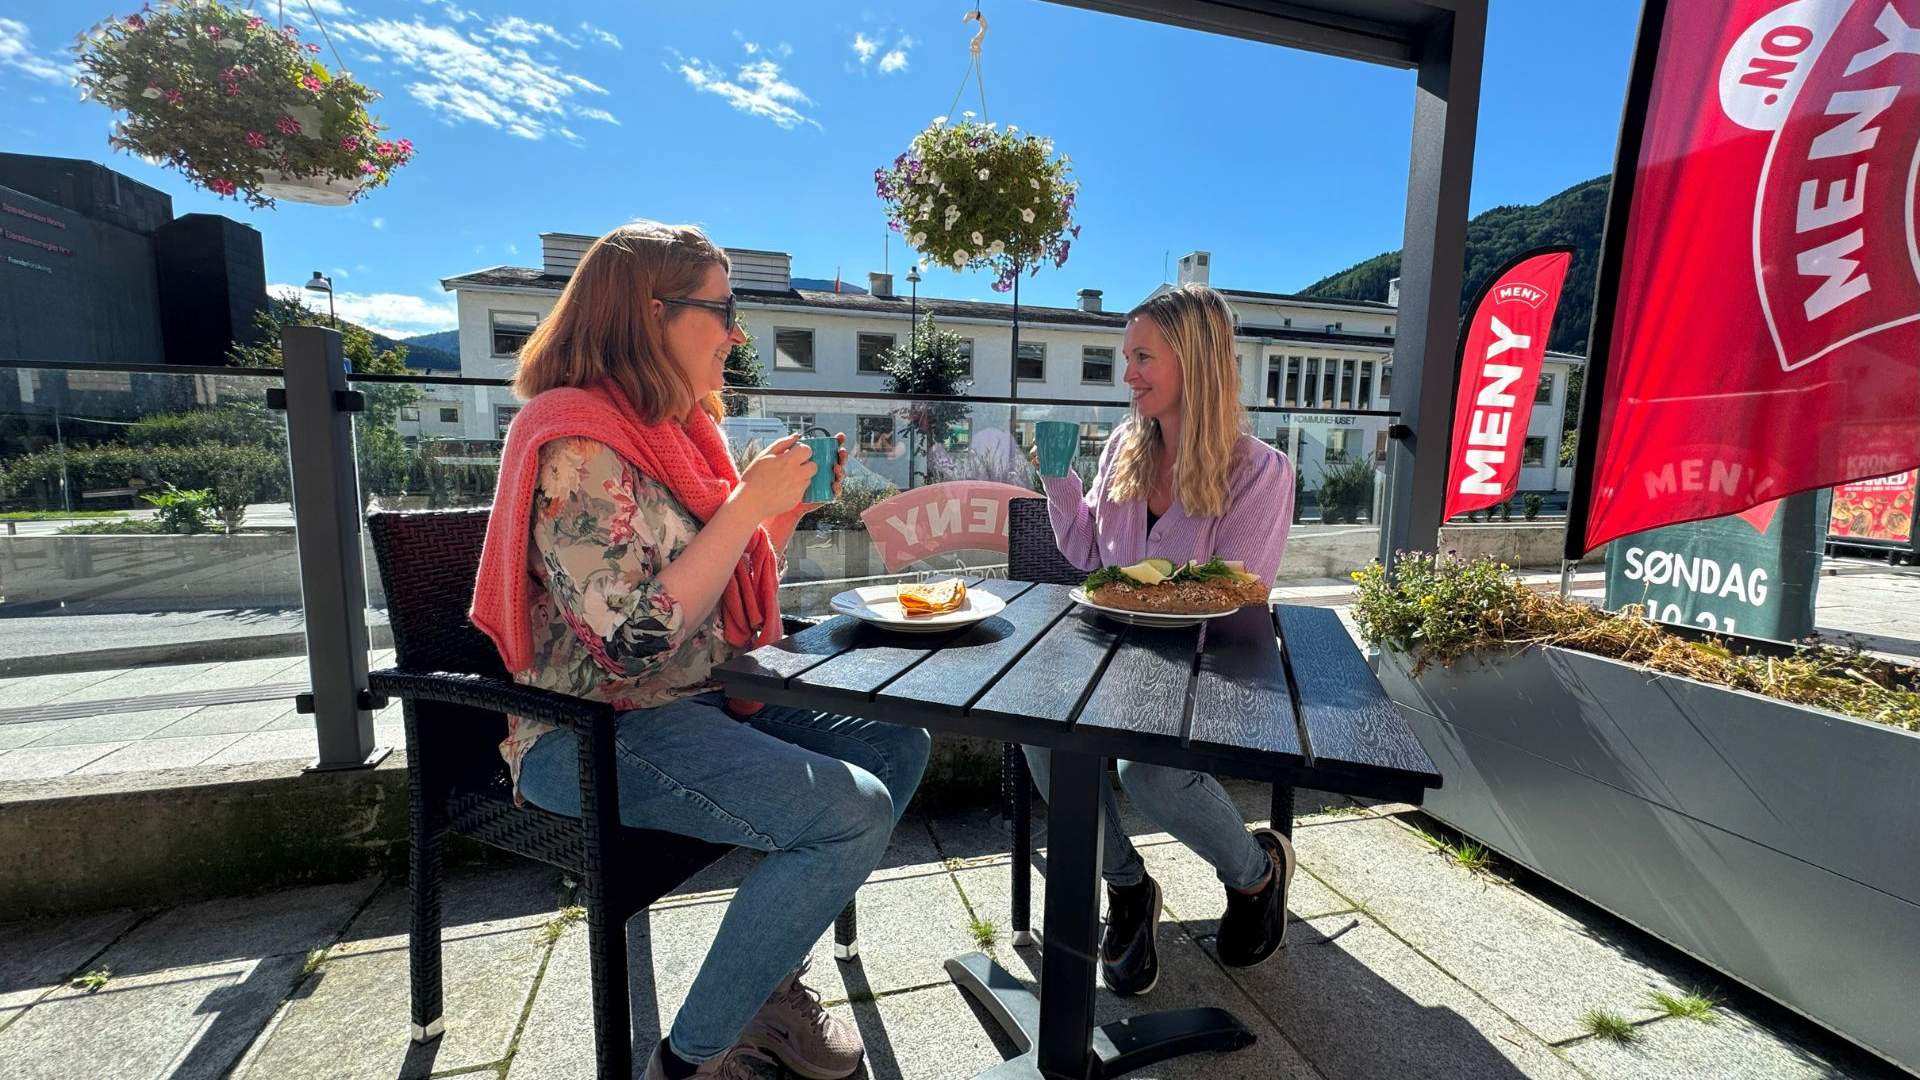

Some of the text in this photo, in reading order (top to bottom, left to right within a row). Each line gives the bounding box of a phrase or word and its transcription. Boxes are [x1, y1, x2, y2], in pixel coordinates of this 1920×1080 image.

[1796, 2, 1920, 321] MENY
[1500, 287, 1541, 302] MENY
[1459, 315, 1532, 495] MENY
[1624, 547, 1768, 607] SØNDAG
